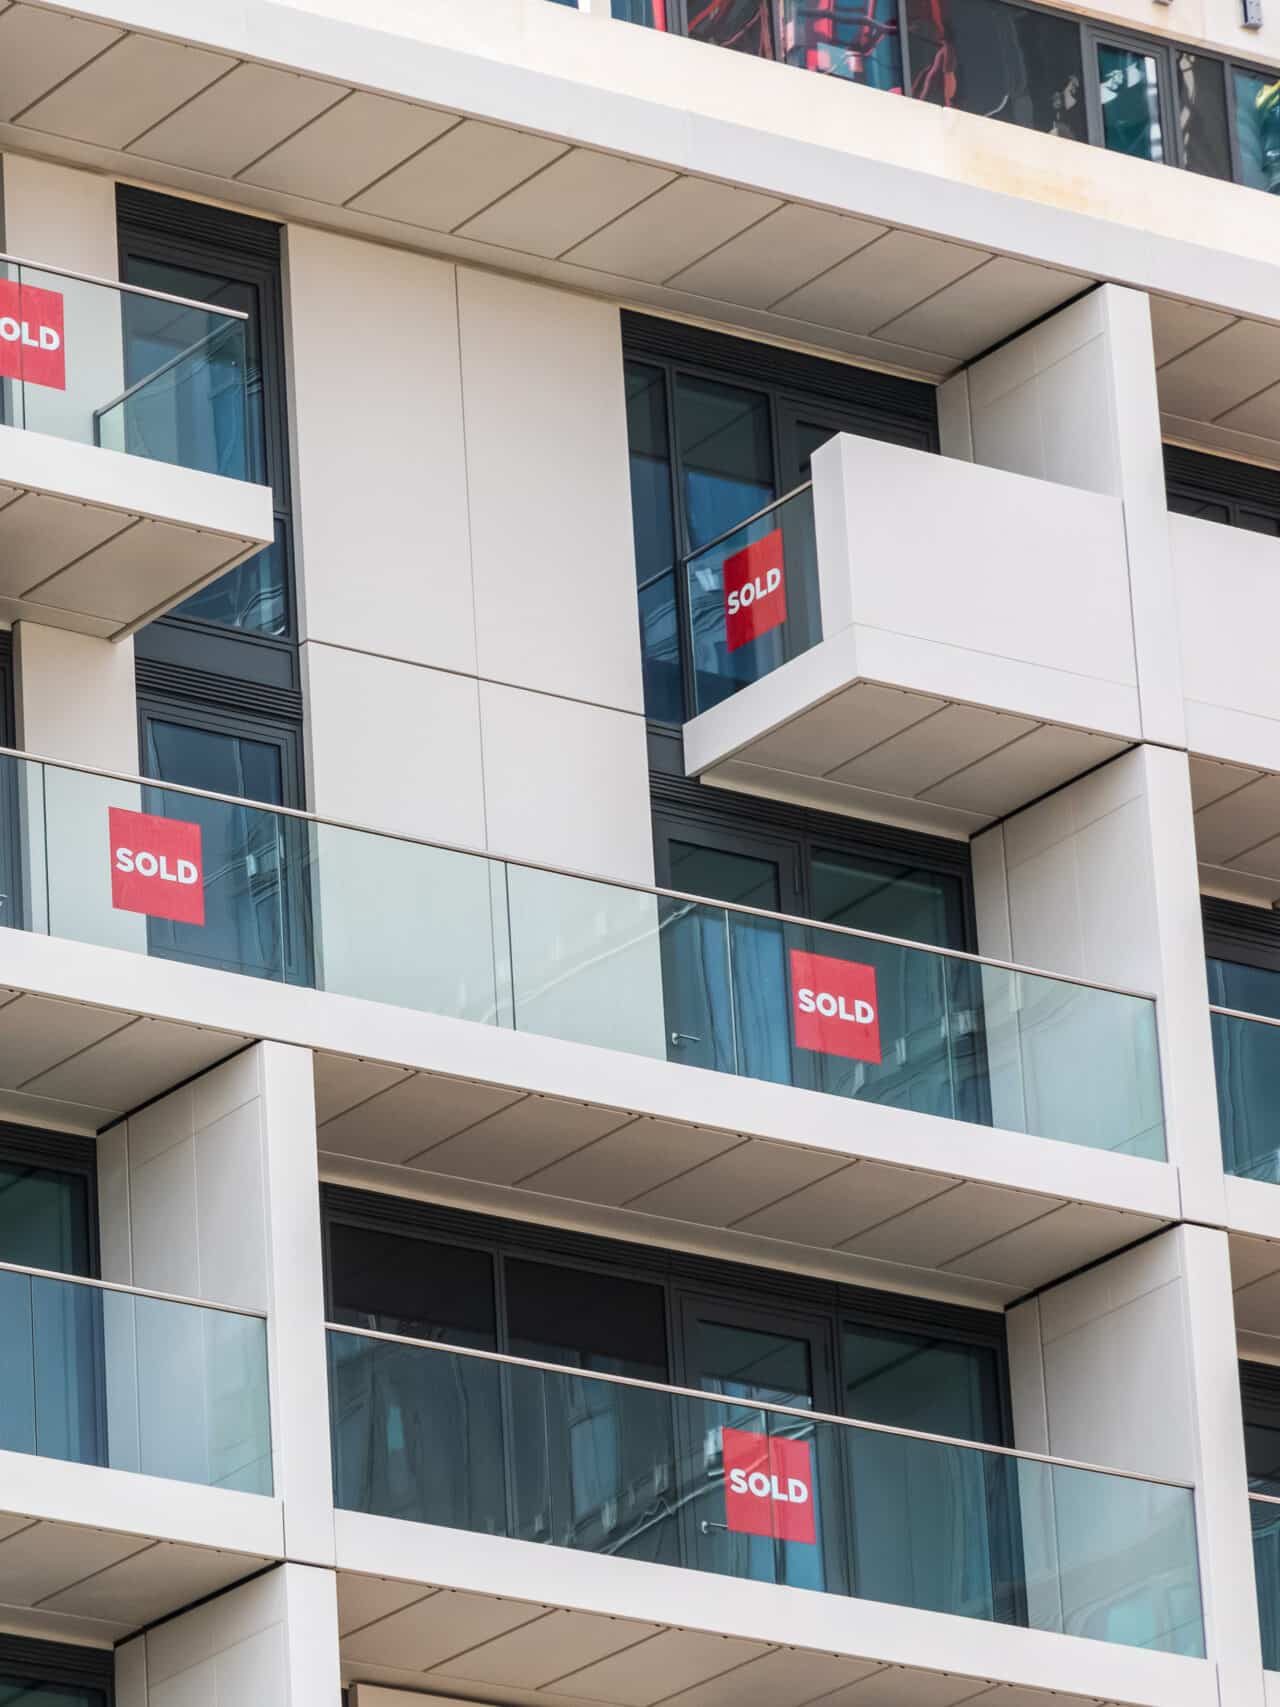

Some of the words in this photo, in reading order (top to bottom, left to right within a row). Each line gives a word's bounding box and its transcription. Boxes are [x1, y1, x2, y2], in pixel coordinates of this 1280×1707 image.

[727, 567, 782, 615] SOLD
[115, 847, 200, 885] SOLD
[797, 988, 875, 1025] SOLD
[729, 1468, 809, 1504] SOLD
